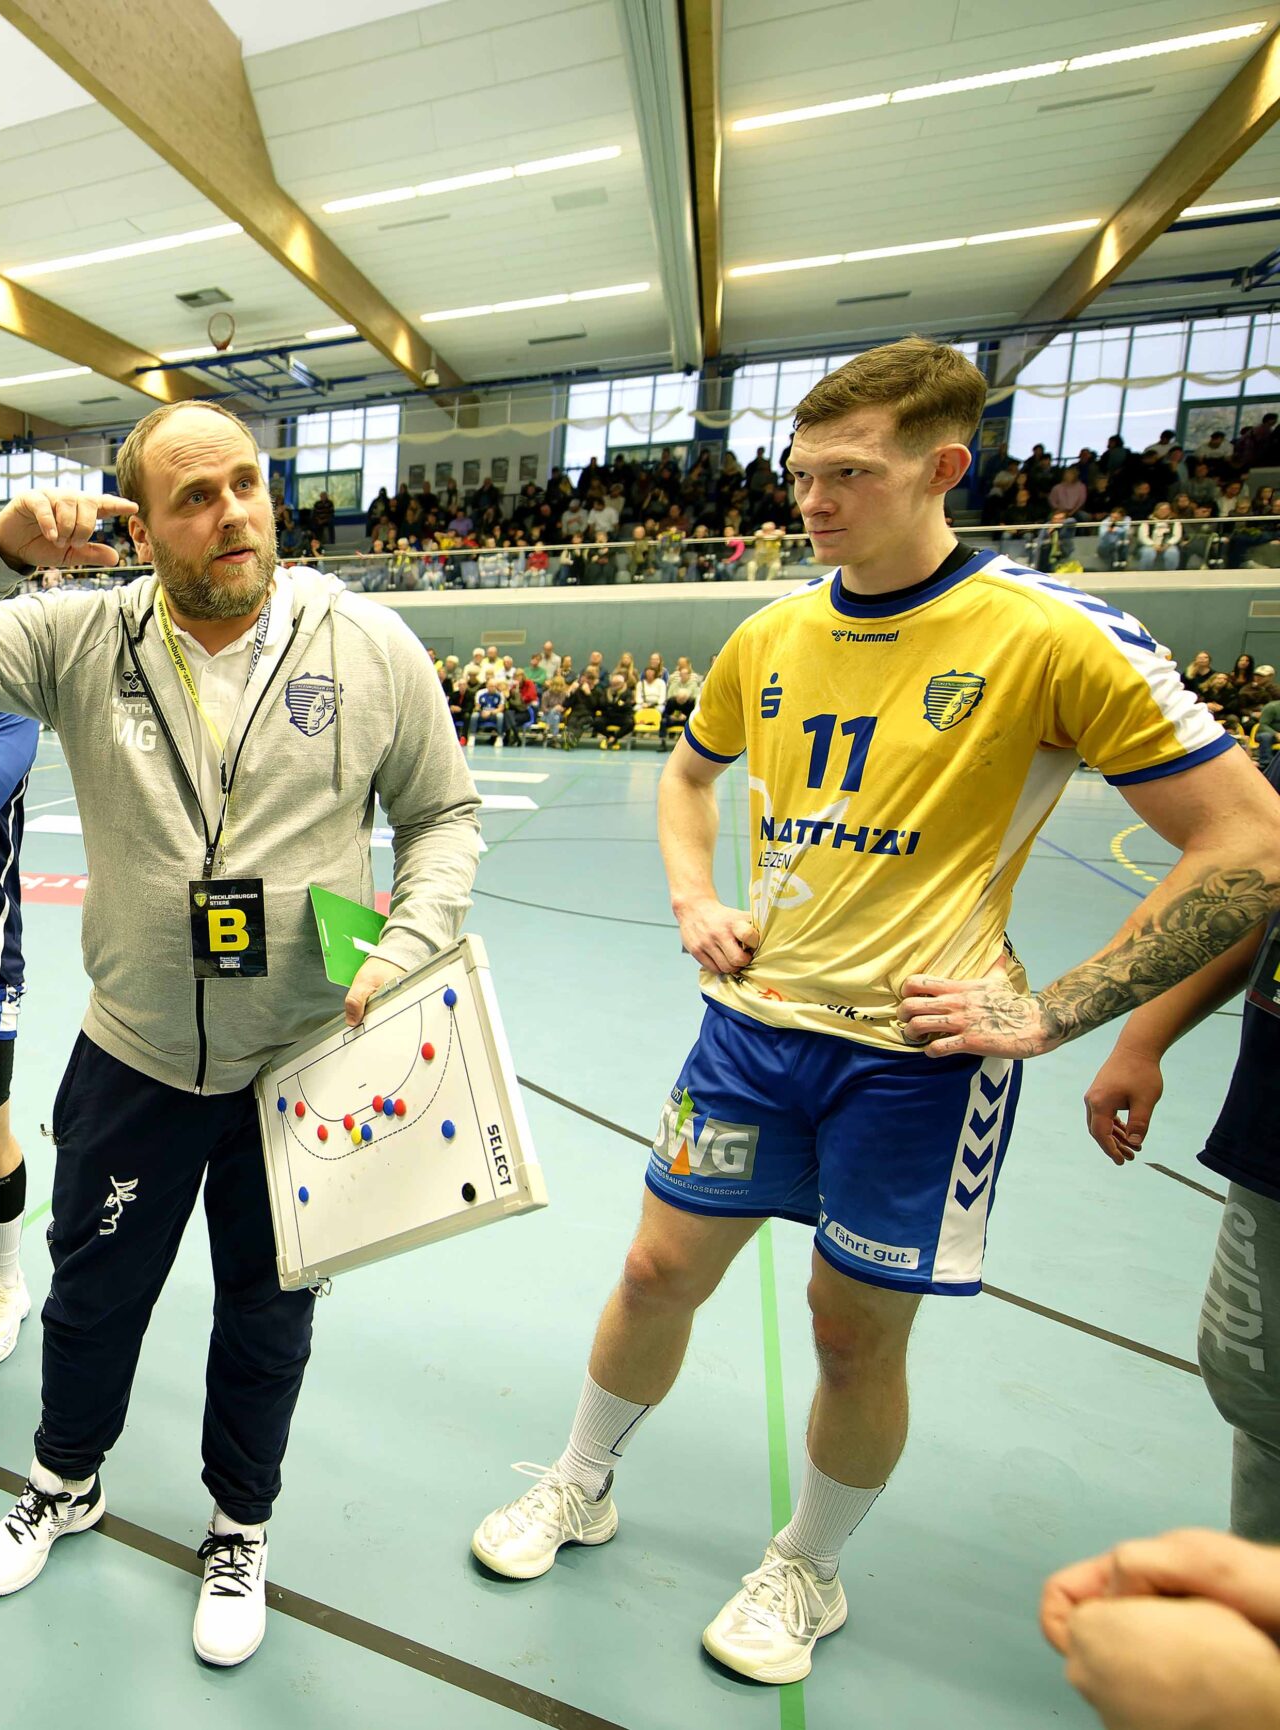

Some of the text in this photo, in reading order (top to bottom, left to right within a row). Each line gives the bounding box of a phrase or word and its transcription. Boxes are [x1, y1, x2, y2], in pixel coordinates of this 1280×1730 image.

[847, 630, 900, 642] hummel
[120, 689, 149, 698] humme
[112, 713, 157, 752] MG
[803, 714, 878, 792] 11
[208, 909, 250, 952] B
[487, 1124, 511, 1185] SELECT
[835, 1226, 911, 1263] fährt gut.
